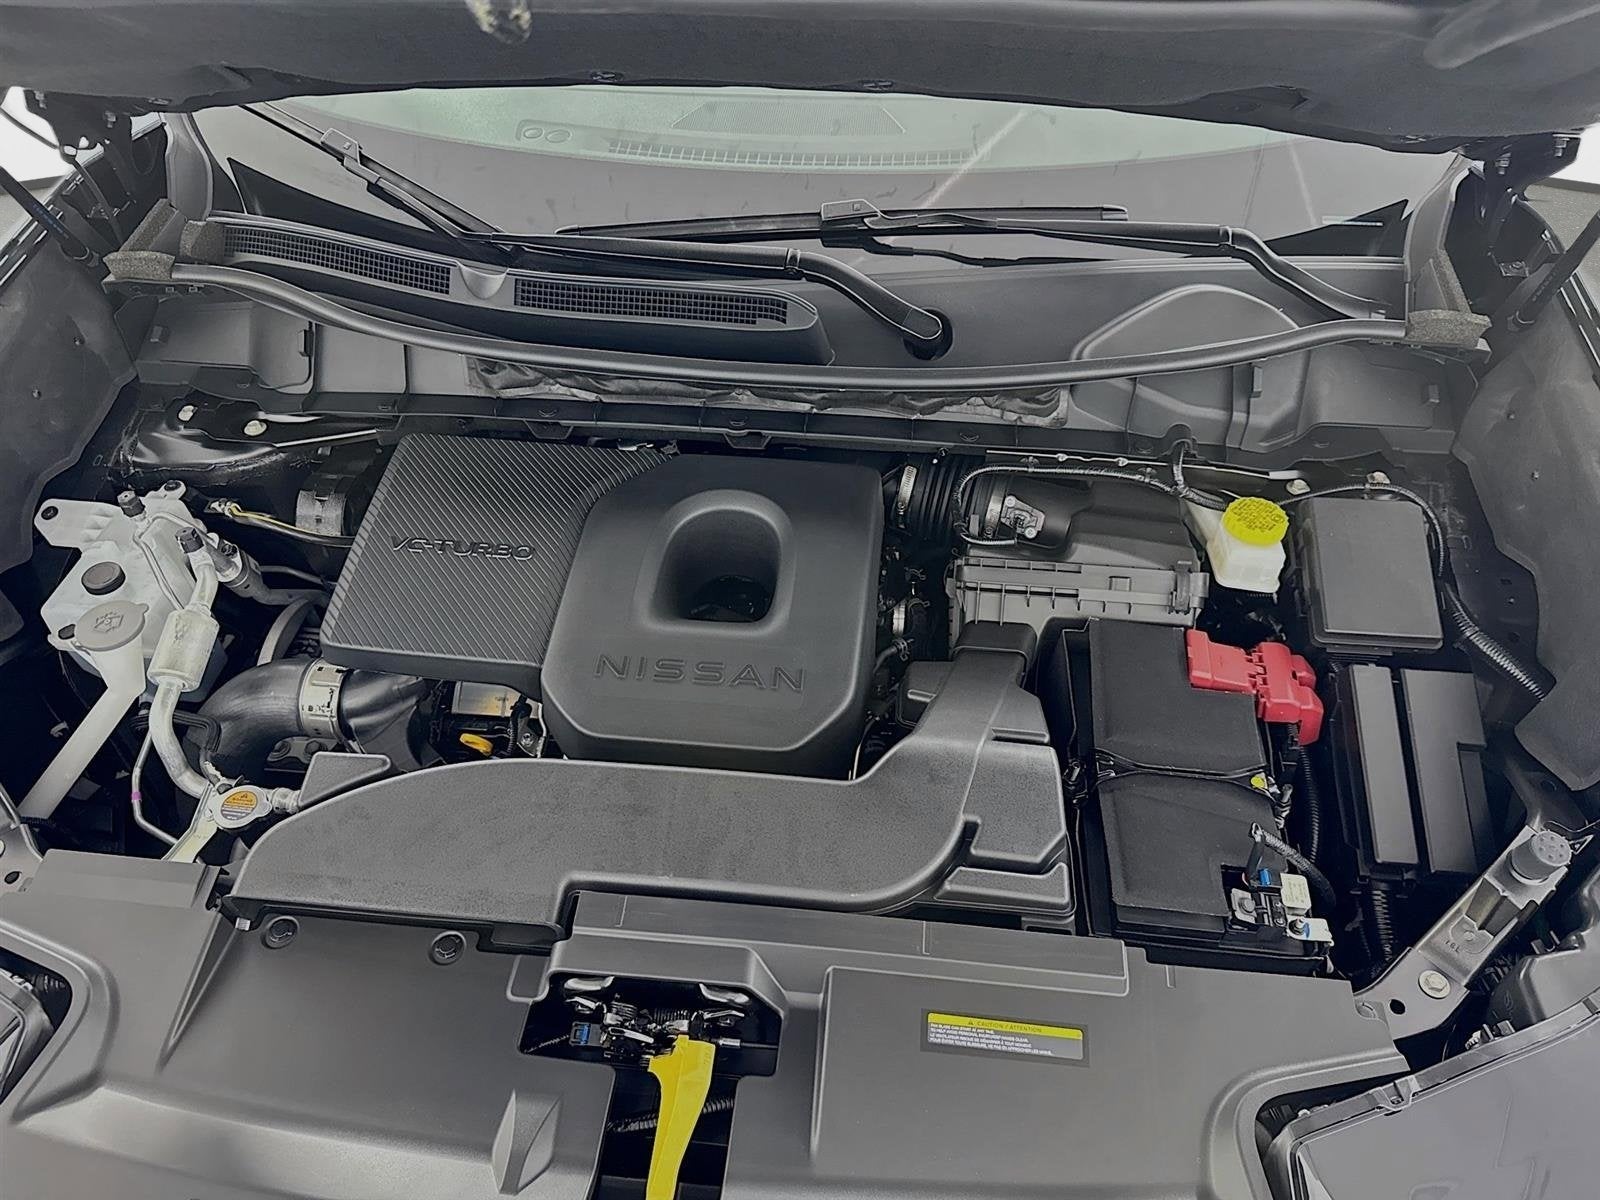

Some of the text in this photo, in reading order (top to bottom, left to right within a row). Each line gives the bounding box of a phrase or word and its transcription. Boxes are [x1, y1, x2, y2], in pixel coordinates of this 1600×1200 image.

[391, 536, 535, 561] VC-TURBO
[593, 653, 806, 693] NISSAN
[1009, 1023, 1042, 1033] ATTENTION
